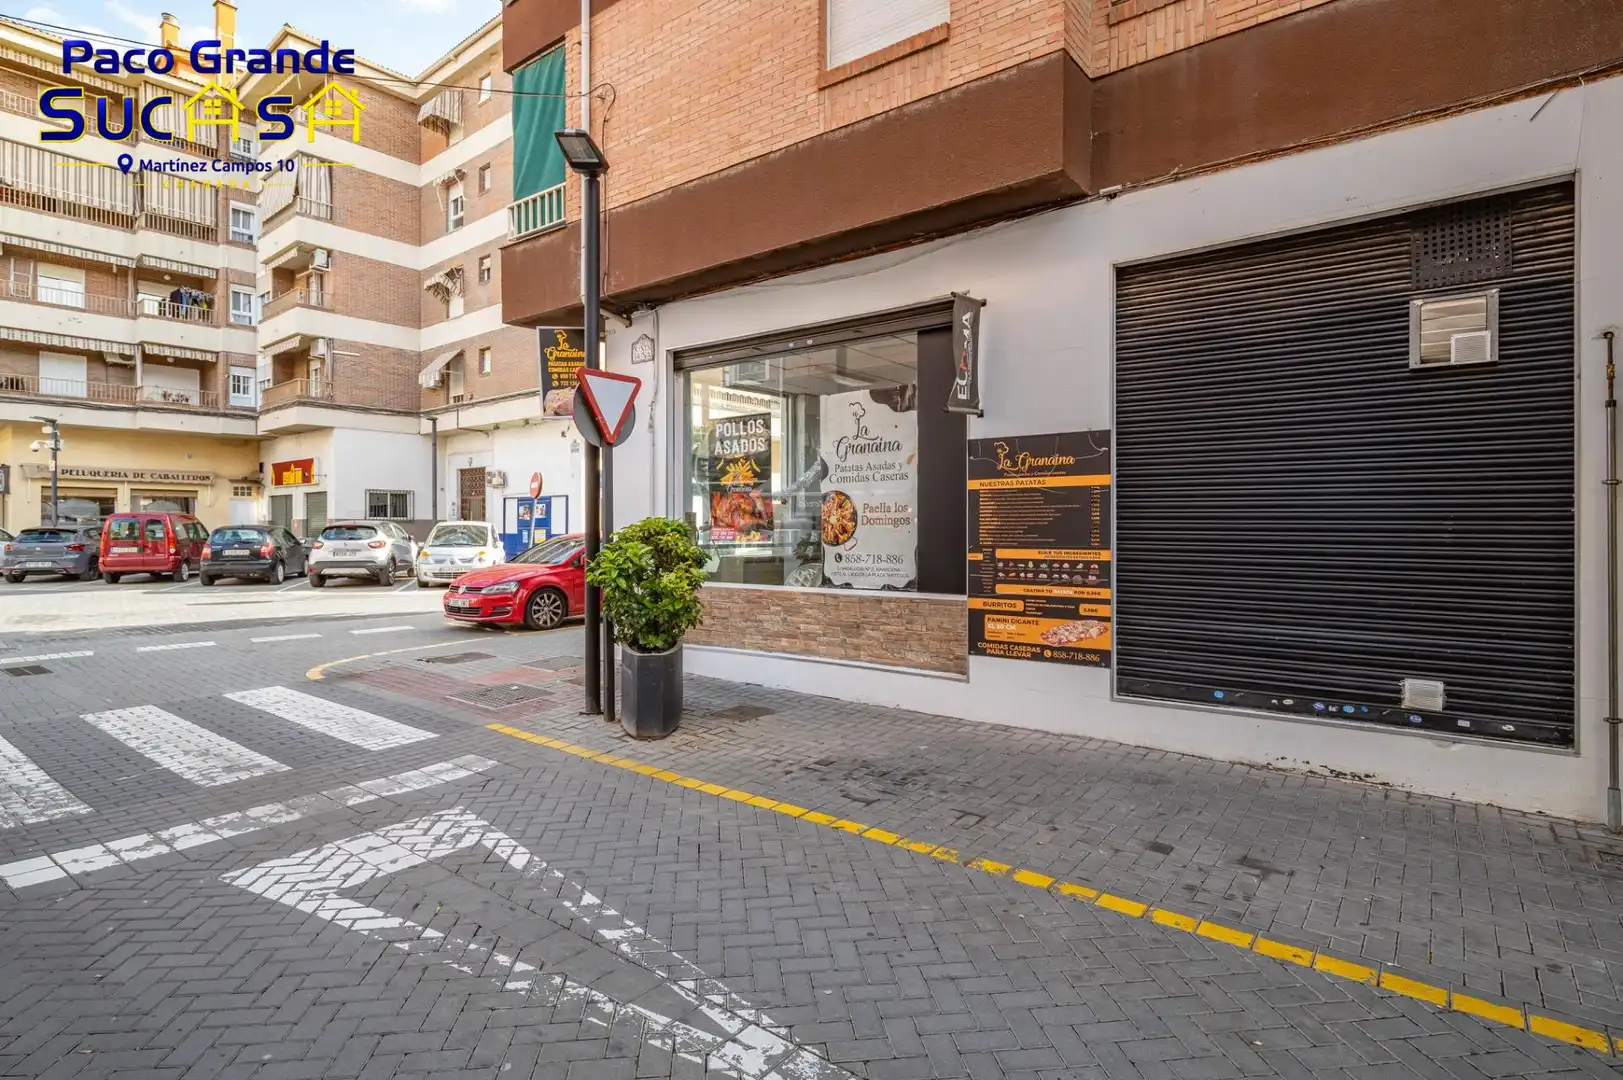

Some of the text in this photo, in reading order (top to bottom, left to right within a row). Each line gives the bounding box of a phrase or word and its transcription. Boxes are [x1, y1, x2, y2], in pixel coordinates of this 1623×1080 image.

[715, 419, 764, 437] POLLOS
[852, 417, 879, 441] La
[714, 437, 766, 455] ASADOS
[834, 460, 904, 473] Patatas Asadas y
[997, 452, 1019, 471] La
[61, 468, 129, 479] PELUQUERIA
[829, 471, 909, 484] Comidas Caseras
[863, 502, 909, 514] Paella los
[861, 515, 911, 528] Domingos
[844, 553, 904, 565] 858-718-886
[982, 601, 1017, 609] BURRITOS
[977, 641, 1041, 653] COMIDAS CASERAS
[986, 648, 1031, 658] PARA LLEVAR
[1052, 651, 1100, 662] 858-718-886
